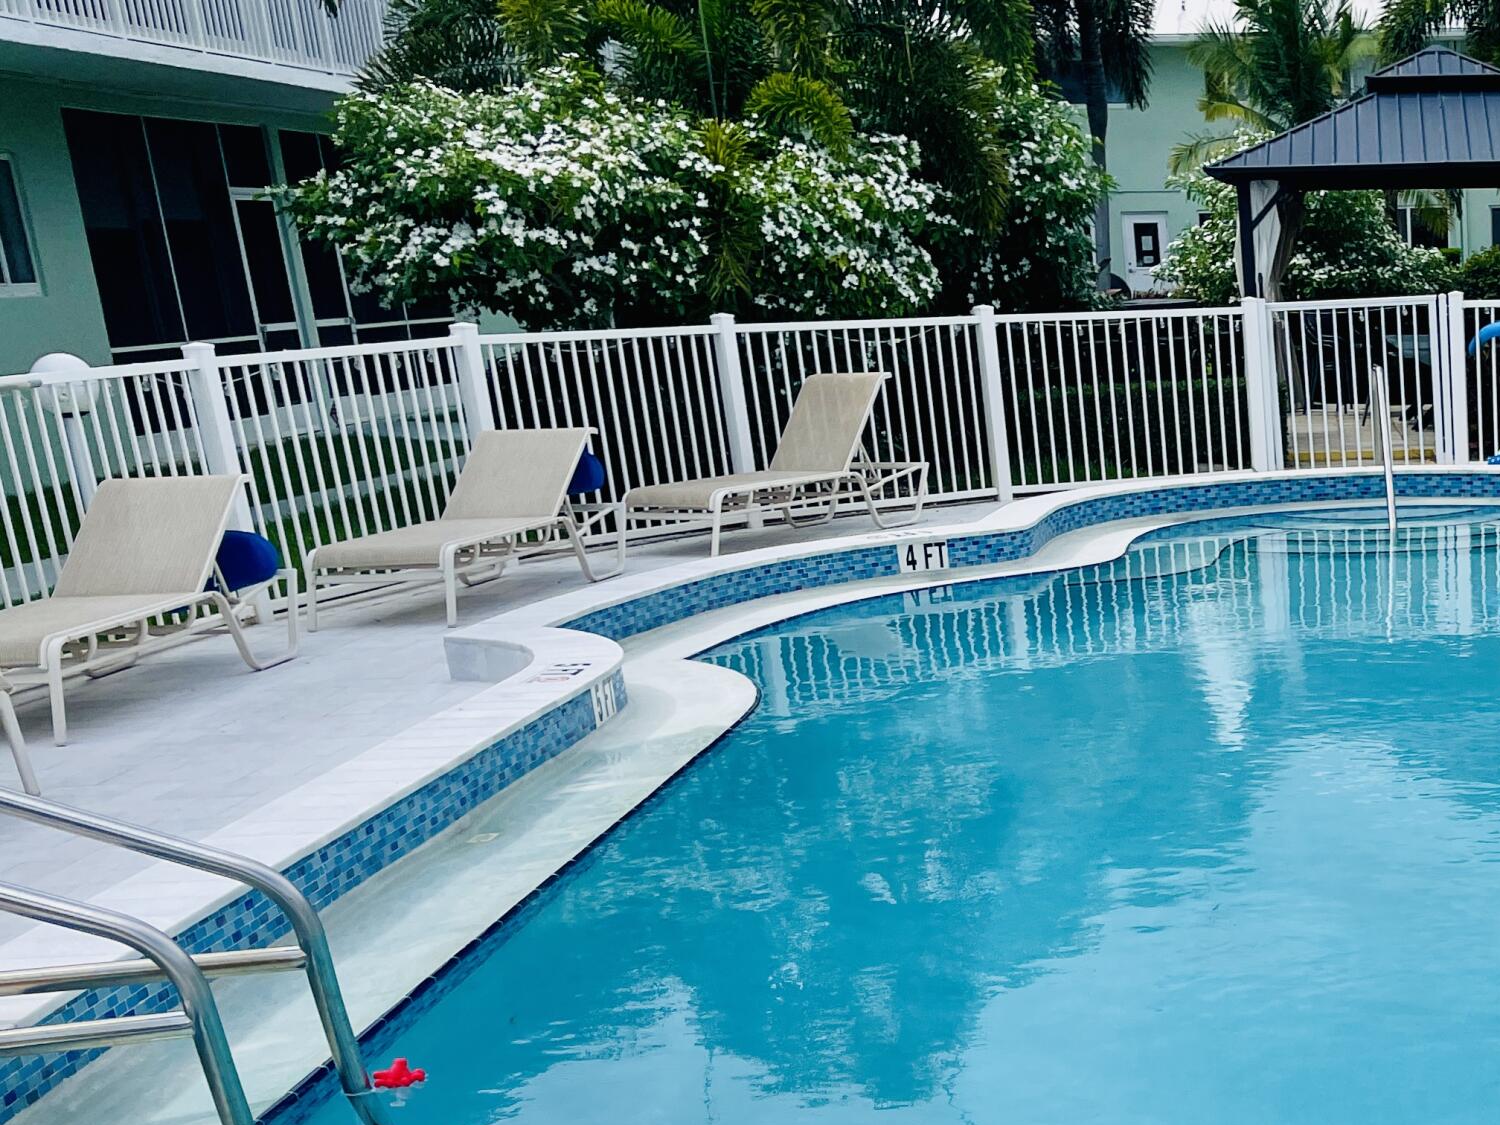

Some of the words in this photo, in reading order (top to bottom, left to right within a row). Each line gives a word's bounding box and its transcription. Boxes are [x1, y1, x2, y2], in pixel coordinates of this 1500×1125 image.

[906, 544, 917, 571] 4
[923, 541, 946, 569] FT
[602, 677, 617, 717] FT
